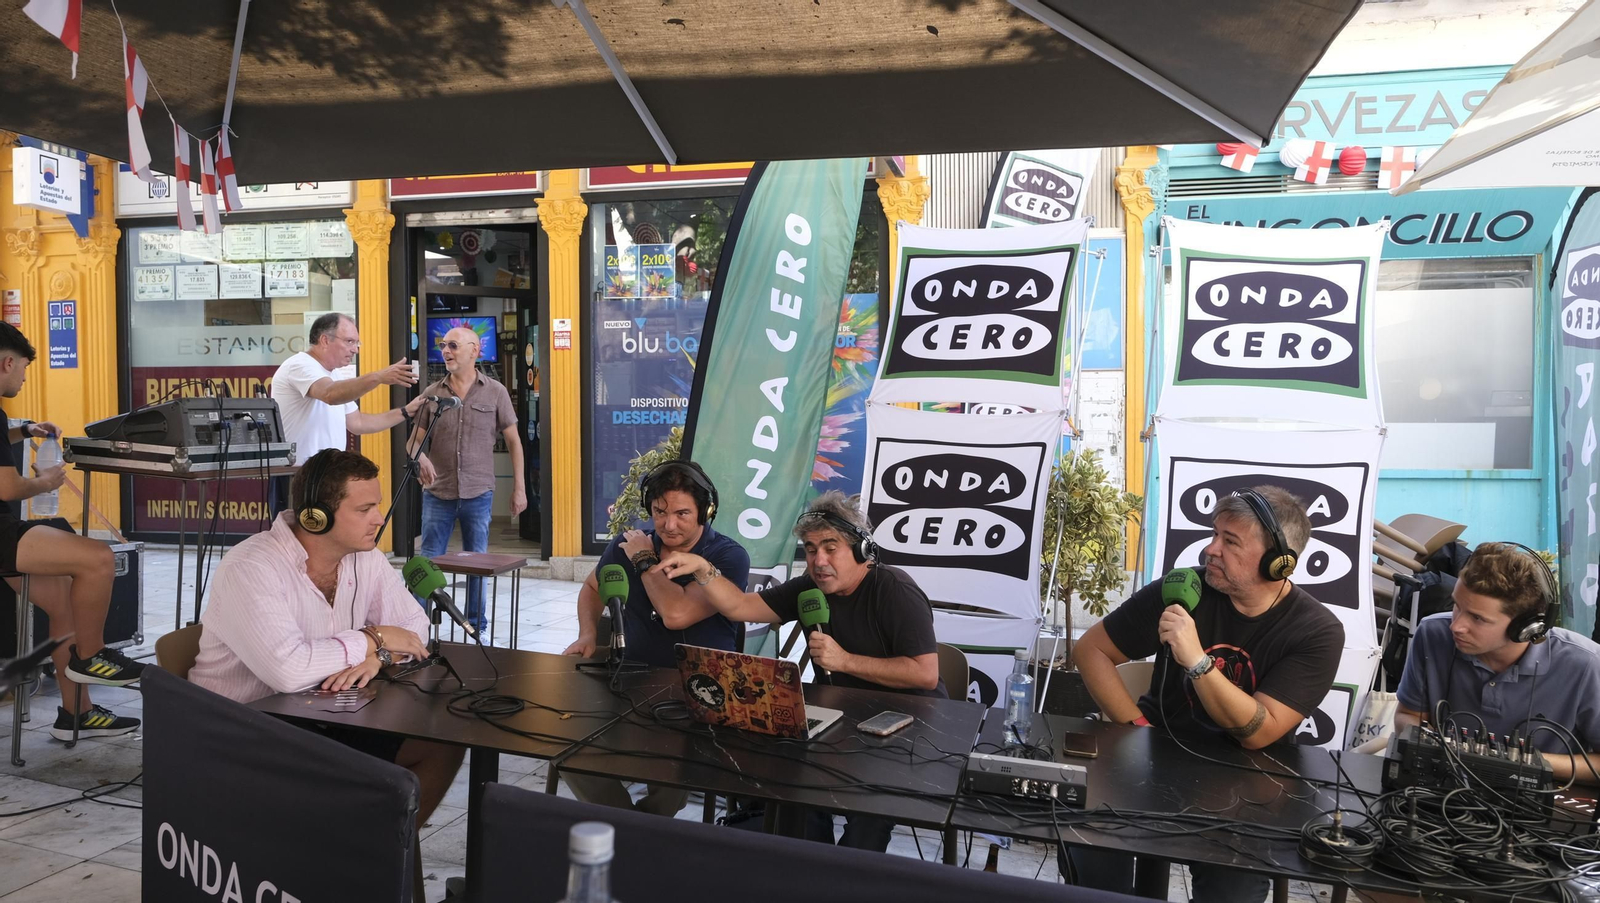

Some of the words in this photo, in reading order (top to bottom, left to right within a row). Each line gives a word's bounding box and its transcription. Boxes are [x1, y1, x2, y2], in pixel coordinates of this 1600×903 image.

[1018, 171, 1068, 197] ONDA
[40, 196, 58, 204] Estado
[1015, 193, 1063, 219] CERO
[1187, 205, 1210, 219] EL
[138, 274, 170, 283] 41357
[270, 270, 304, 279] 17183
[766, 212, 812, 352] CERO
[924, 278, 1038, 302] ONDA
[1209, 284, 1333, 310] ONDA
[178, 336, 305, 355] ESTANCO
[922, 323, 1033, 351] CERO
[1213, 331, 1332, 360] CERO
[630, 397, 688, 408] DISPOSITIVO
[737, 377, 789, 539] ONDA
[895, 466, 1011, 494] ONDA
[147, 499, 214, 520] INFINITAS
[892, 515, 1006, 549] CERO
